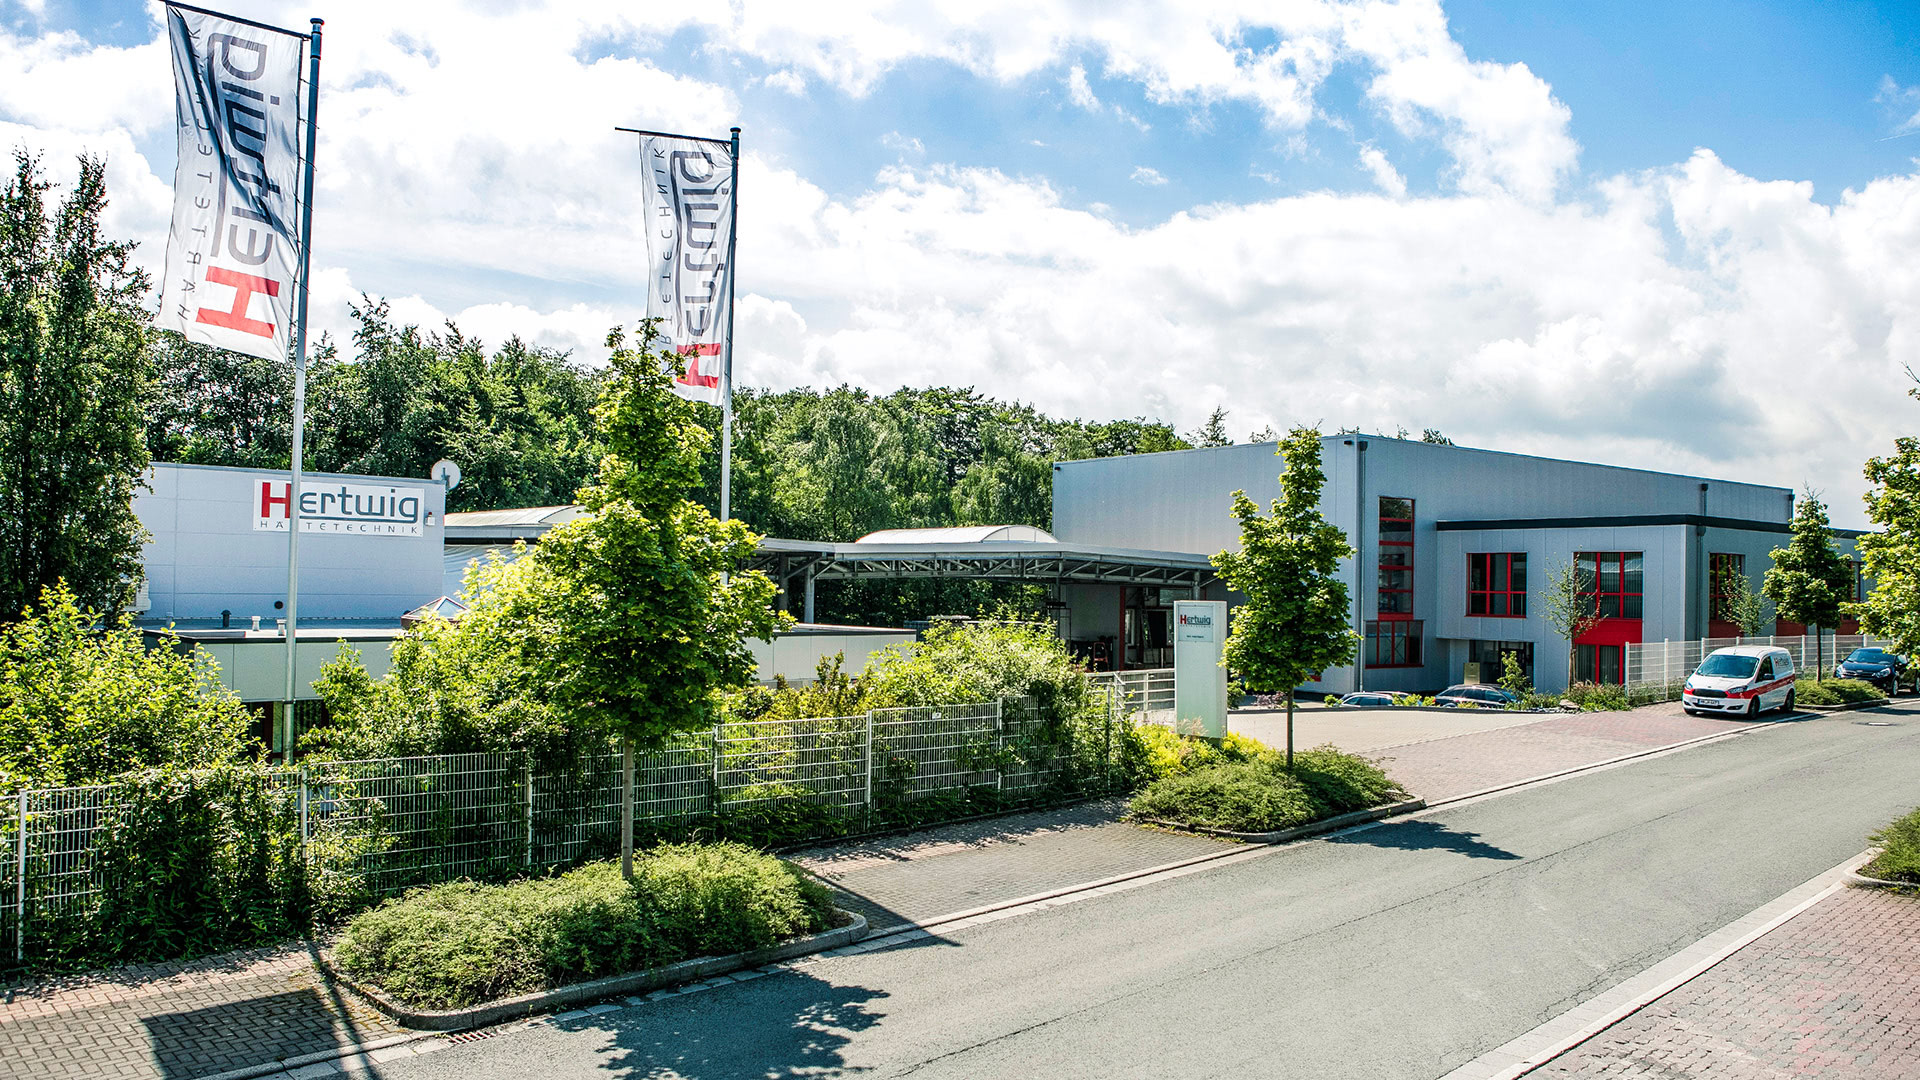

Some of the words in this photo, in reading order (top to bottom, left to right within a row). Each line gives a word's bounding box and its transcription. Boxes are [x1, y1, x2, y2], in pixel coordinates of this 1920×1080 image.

[261, 482, 418, 524] Hertwig
[260, 520, 418, 534] HÄTETECHNIK
[1180, 614, 1211, 625] Hertwig
